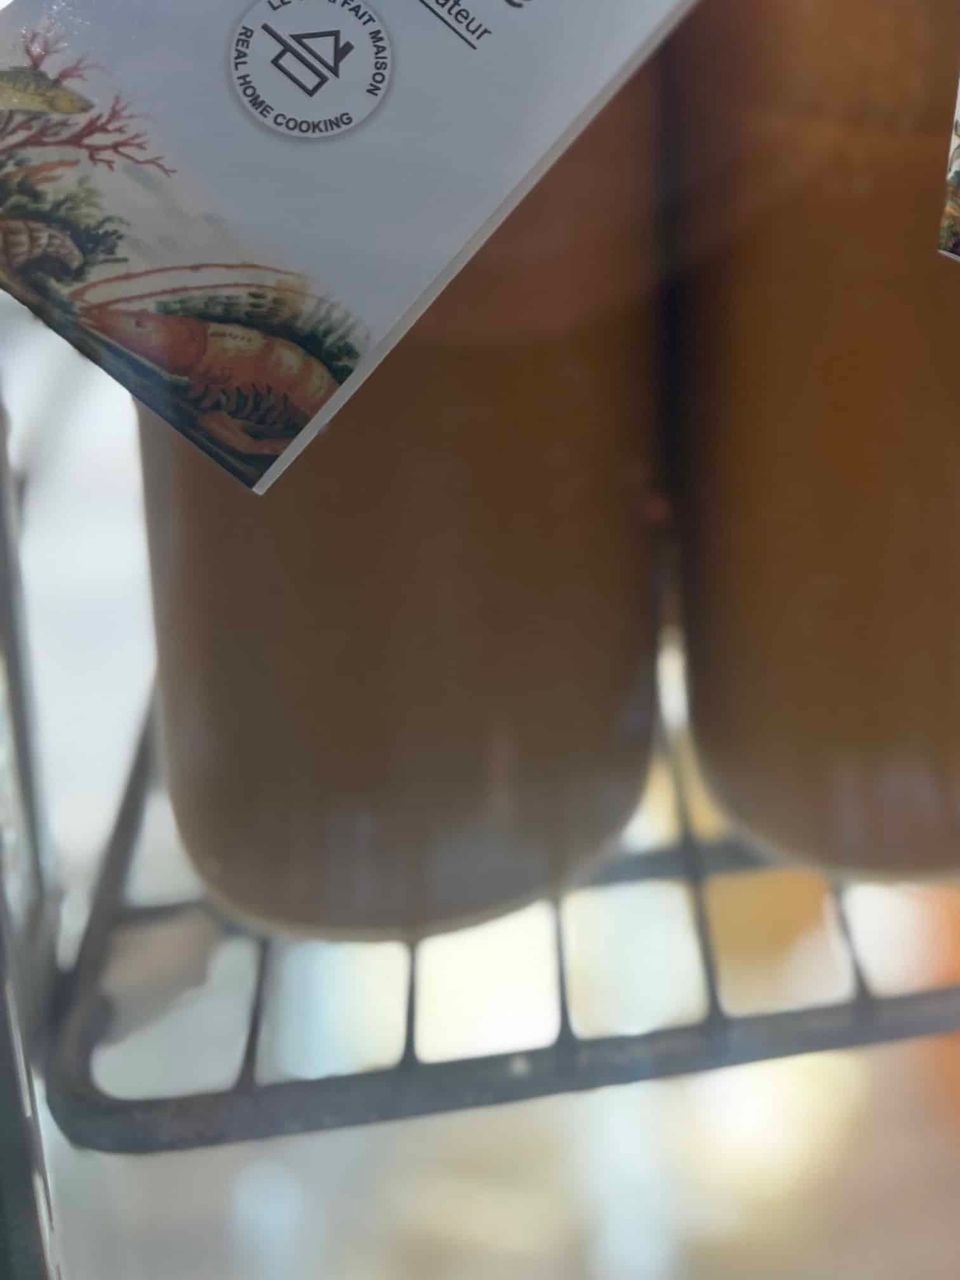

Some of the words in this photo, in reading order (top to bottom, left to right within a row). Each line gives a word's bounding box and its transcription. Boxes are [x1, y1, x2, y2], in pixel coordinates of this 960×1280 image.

[234, 25, 254, 71] REAL
[365, 29, 388, 97] MAISON
[237, 73, 275, 118] HOME
[273, 112, 353, 134] COOKING
